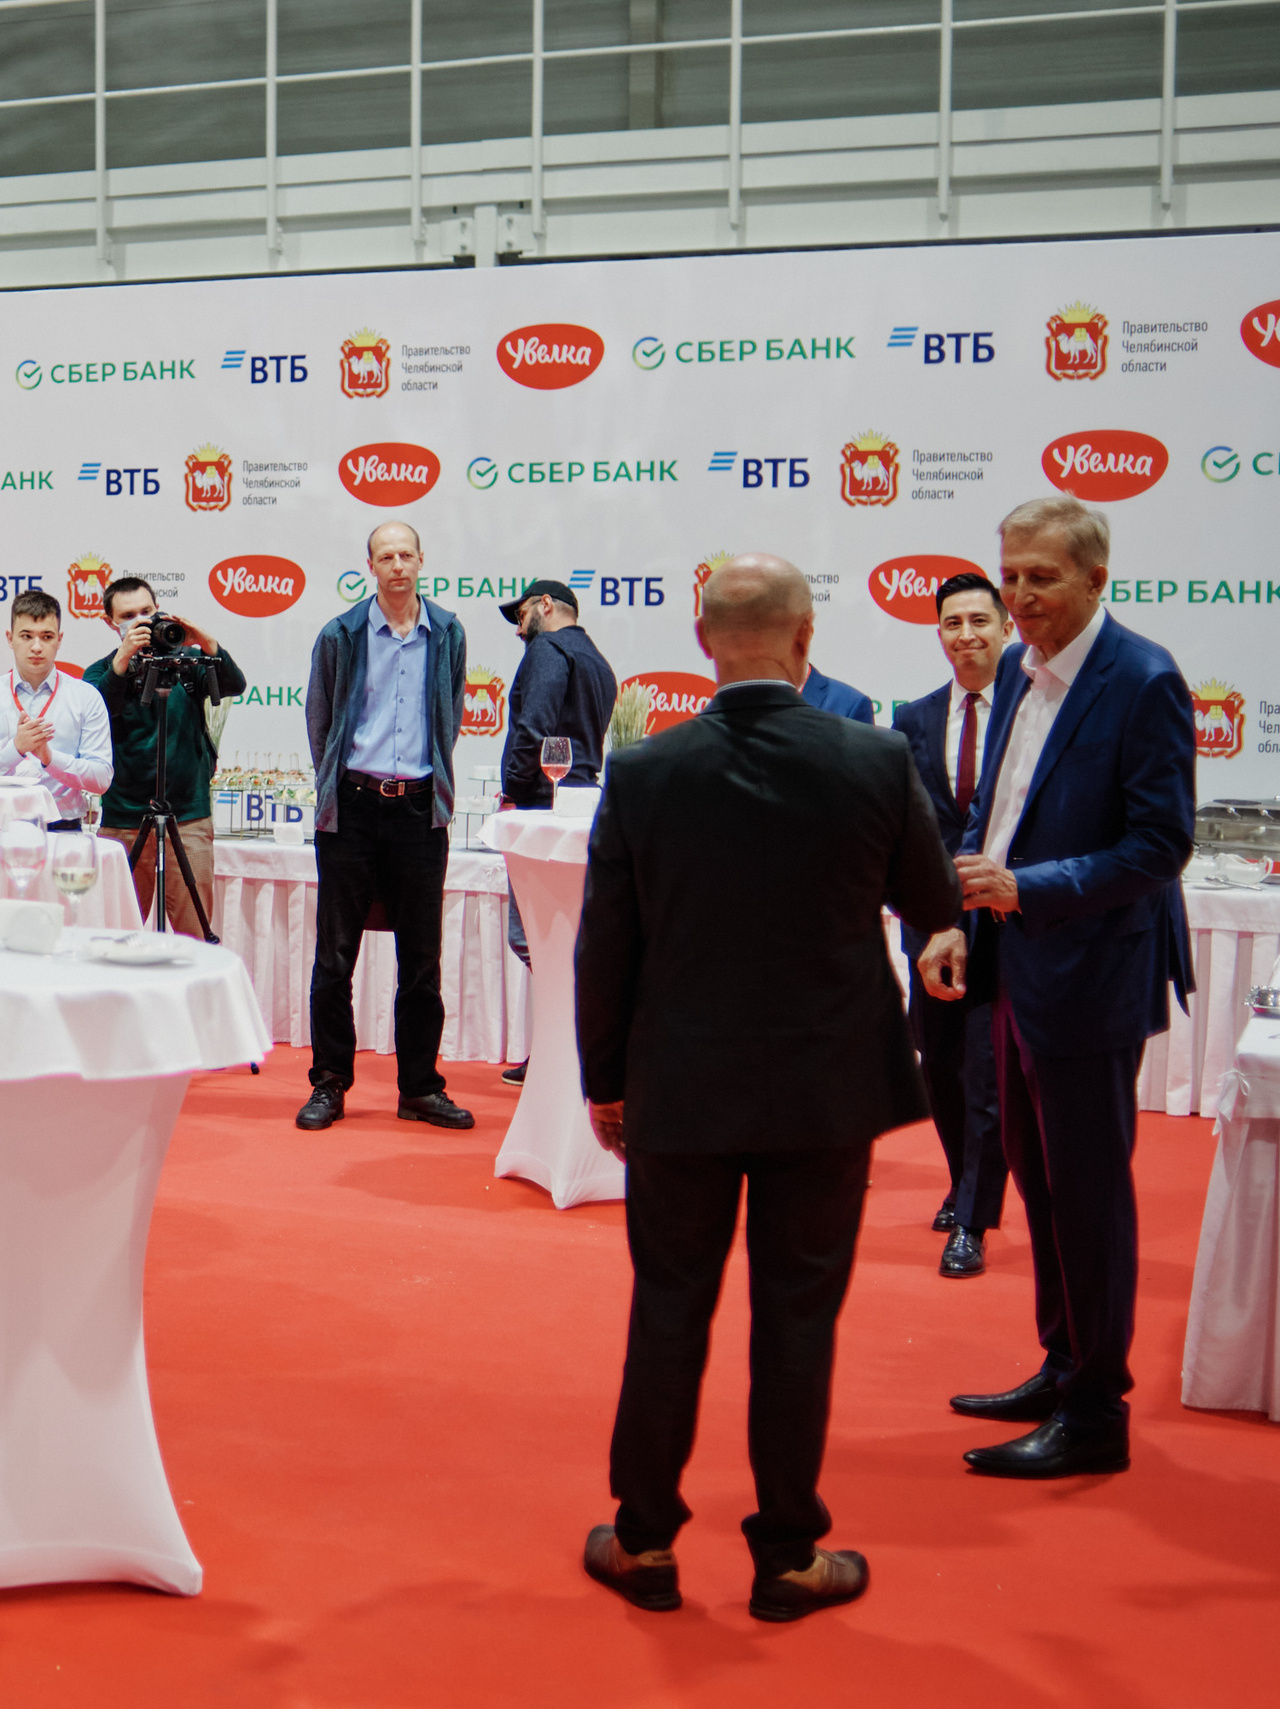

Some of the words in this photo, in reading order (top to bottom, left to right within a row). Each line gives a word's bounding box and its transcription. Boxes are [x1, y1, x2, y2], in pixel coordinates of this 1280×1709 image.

[1123, 321, 1208, 336] Правительство
[402, 345, 470, 358] Правительство
[505, 336, 592, 369] Увелка
[676, 341, 757, 363] СБЕР
[766, 338, 854, 360] БАНК
[924, 333, 994, 364] ВТБ
[1122, 339, 1198, 353] Челябинской
[51, 363, 115, 383] СБЕР
[124, 360, 195, 381] БАНК
[251, 355, 307, 384] ВТБ
[402, 361, 463, 373] Челябинской
[1121, 359, 1166, 372] области
[401, 380, 438, 391] области
[243, 460, 307, 474] Правительство
[913, 450, 993, 465] Правительство
[1052, 443, 1153, 478] Увелка
[347, 455, 429, 486] Увелка
[508, 463, 584, 483] СБЕР
[594, 461, 677, 482] БАНК
[743, 458, 810, 488] ВТБ
[912, 468, 983, 481] Челябинской
[106, 469, 160, 495] ВТБ
[243, 477, 300, 489] Челябинской
[912, 487, 954, 499] области
[243, 494, 277, 505] области
[216, 566, 295, 597] Увелка
[601, 577, 664, 606] ВТБ
[1099, 580, 1179, 603] БЕР
